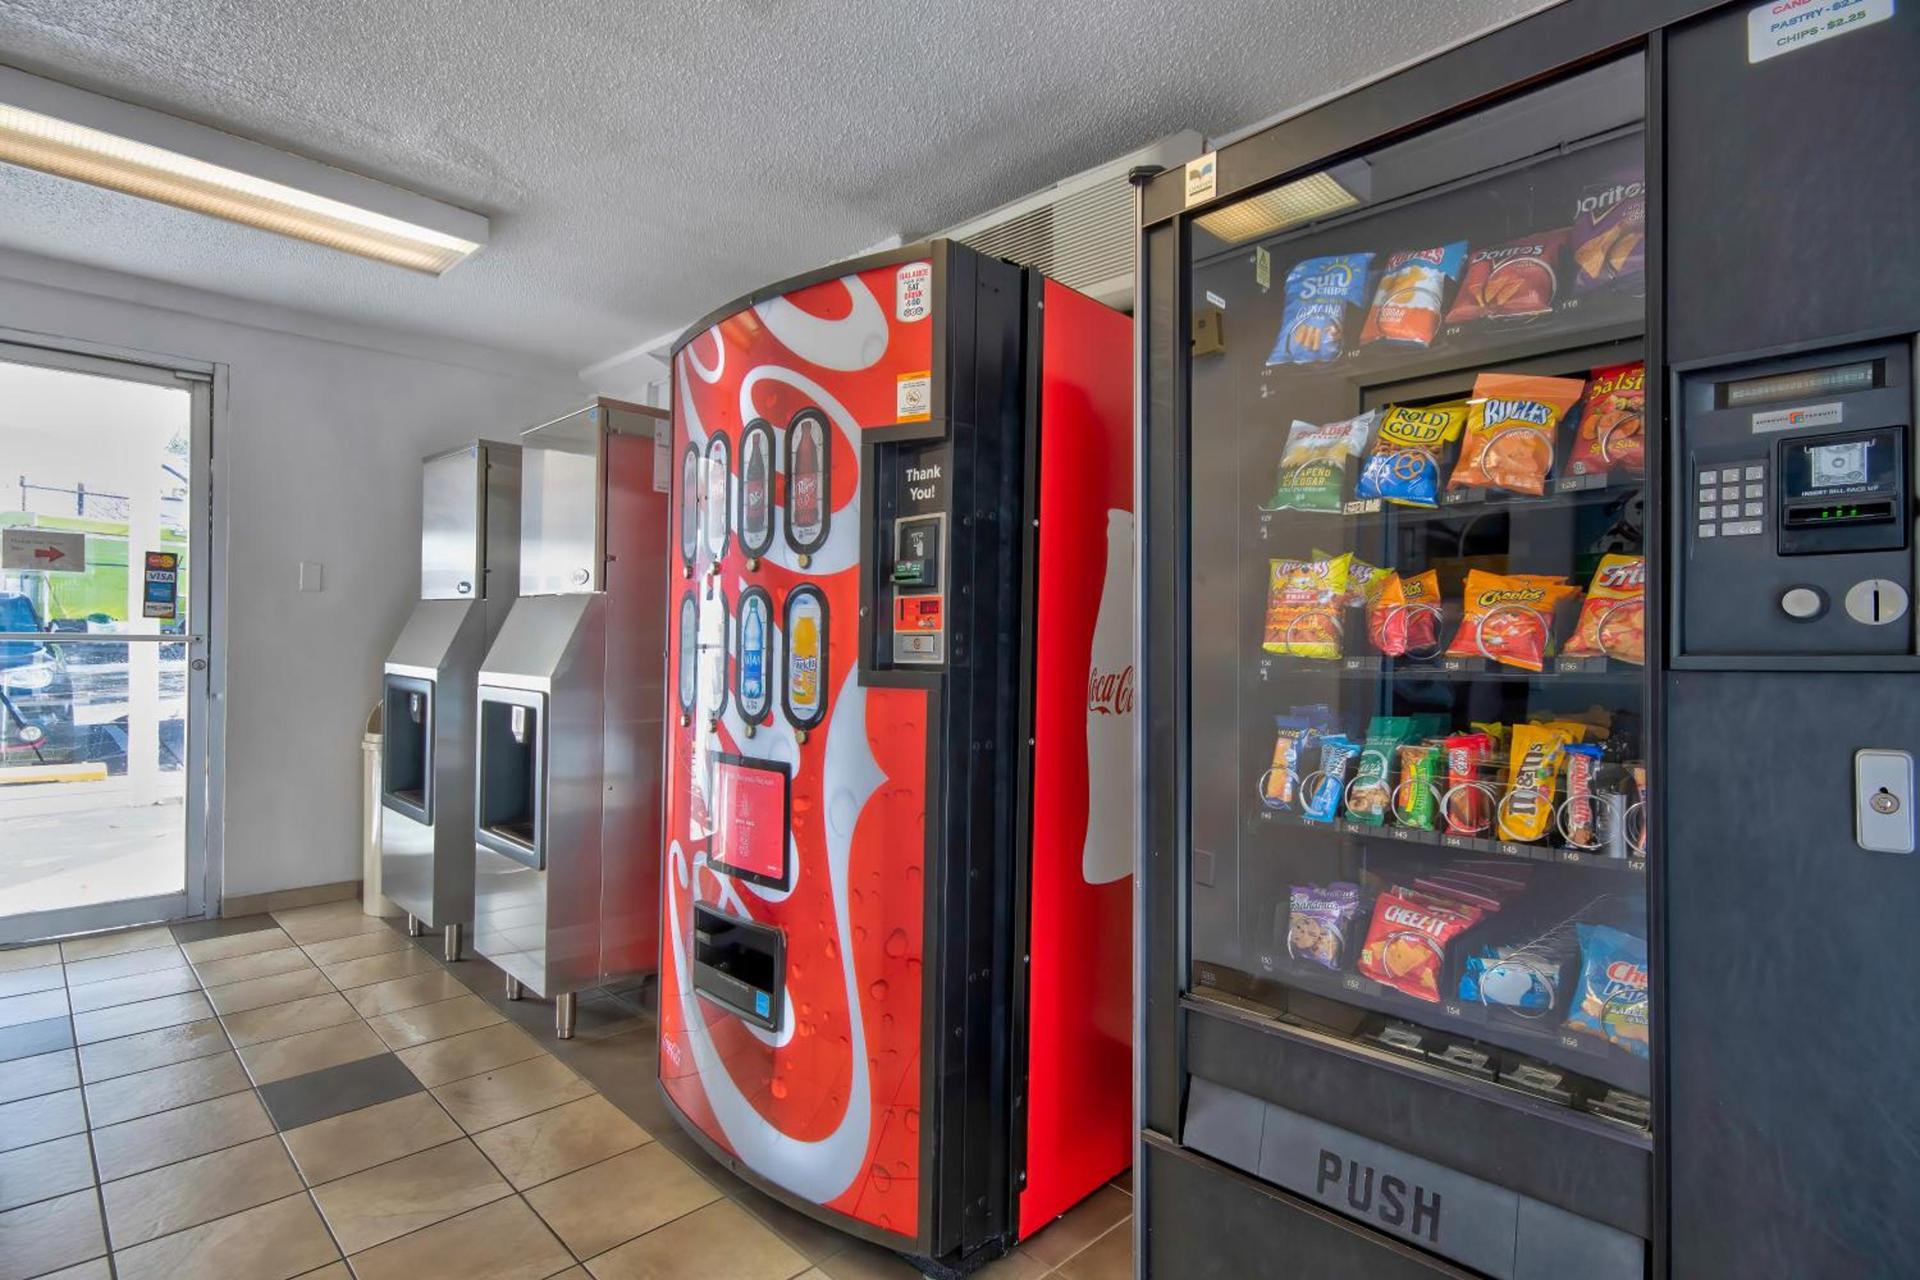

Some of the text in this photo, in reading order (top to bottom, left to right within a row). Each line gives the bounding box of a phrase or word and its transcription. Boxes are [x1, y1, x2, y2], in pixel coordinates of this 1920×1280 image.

[1770, 8, 1824, 32] PASTRY
[1777, 26, 1819, 46] CHIPS
[1827, 10, 1866, 30] $2.25
[1397, 408, 1443, 427] ROLD
[1484, 399, 1551, 428] BUGLES
[1390, 421, 1436, 440] GOLD
[906, 465, 941, 482] Thank
[910, 486, 935, 500] You!
[150, 572, 174, 581] VISA
[1479, 589, 1545, 607] Cheetos
[1502, 845, 1517, 855] 145
[1563, 852, 1579, 862] 146
[1628, 860, 1645, 871] 147
[1316, 1148, 1441, 1243] PUSH
